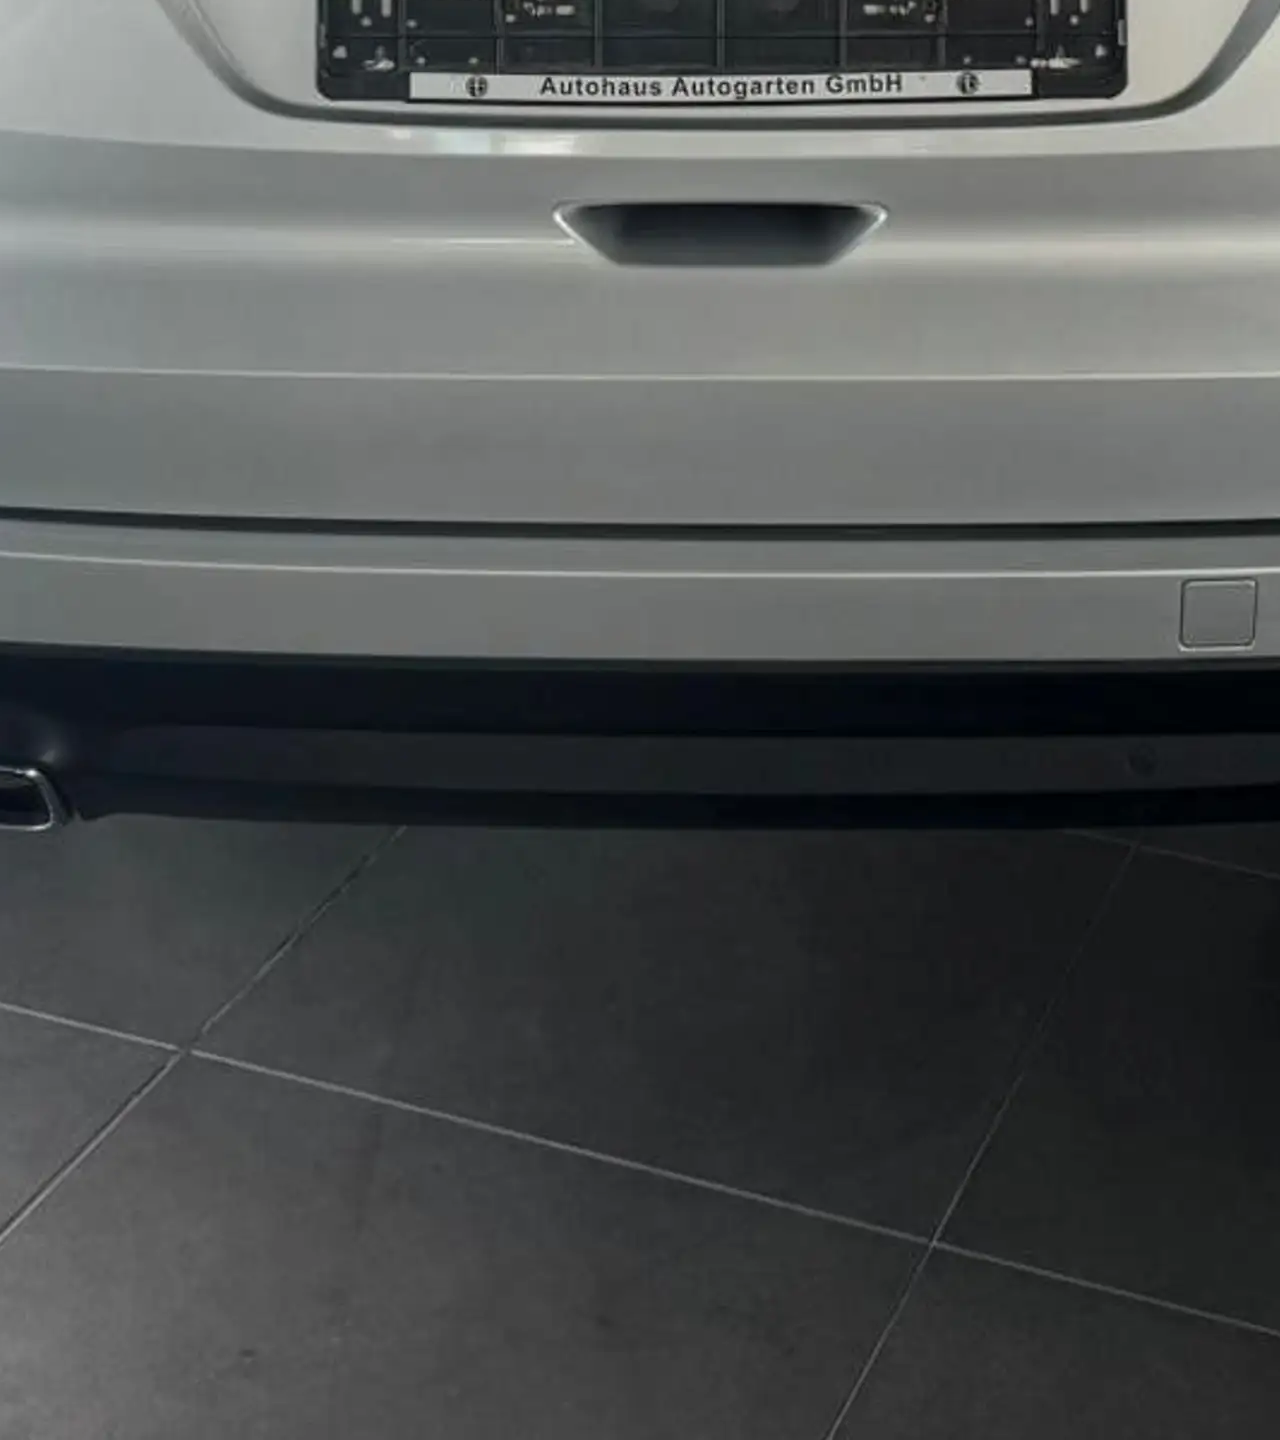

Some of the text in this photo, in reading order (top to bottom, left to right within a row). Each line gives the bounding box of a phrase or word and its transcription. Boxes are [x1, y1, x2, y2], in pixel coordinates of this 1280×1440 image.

[540, 73, 903, 100] Autohaus Autogarten GmbH
